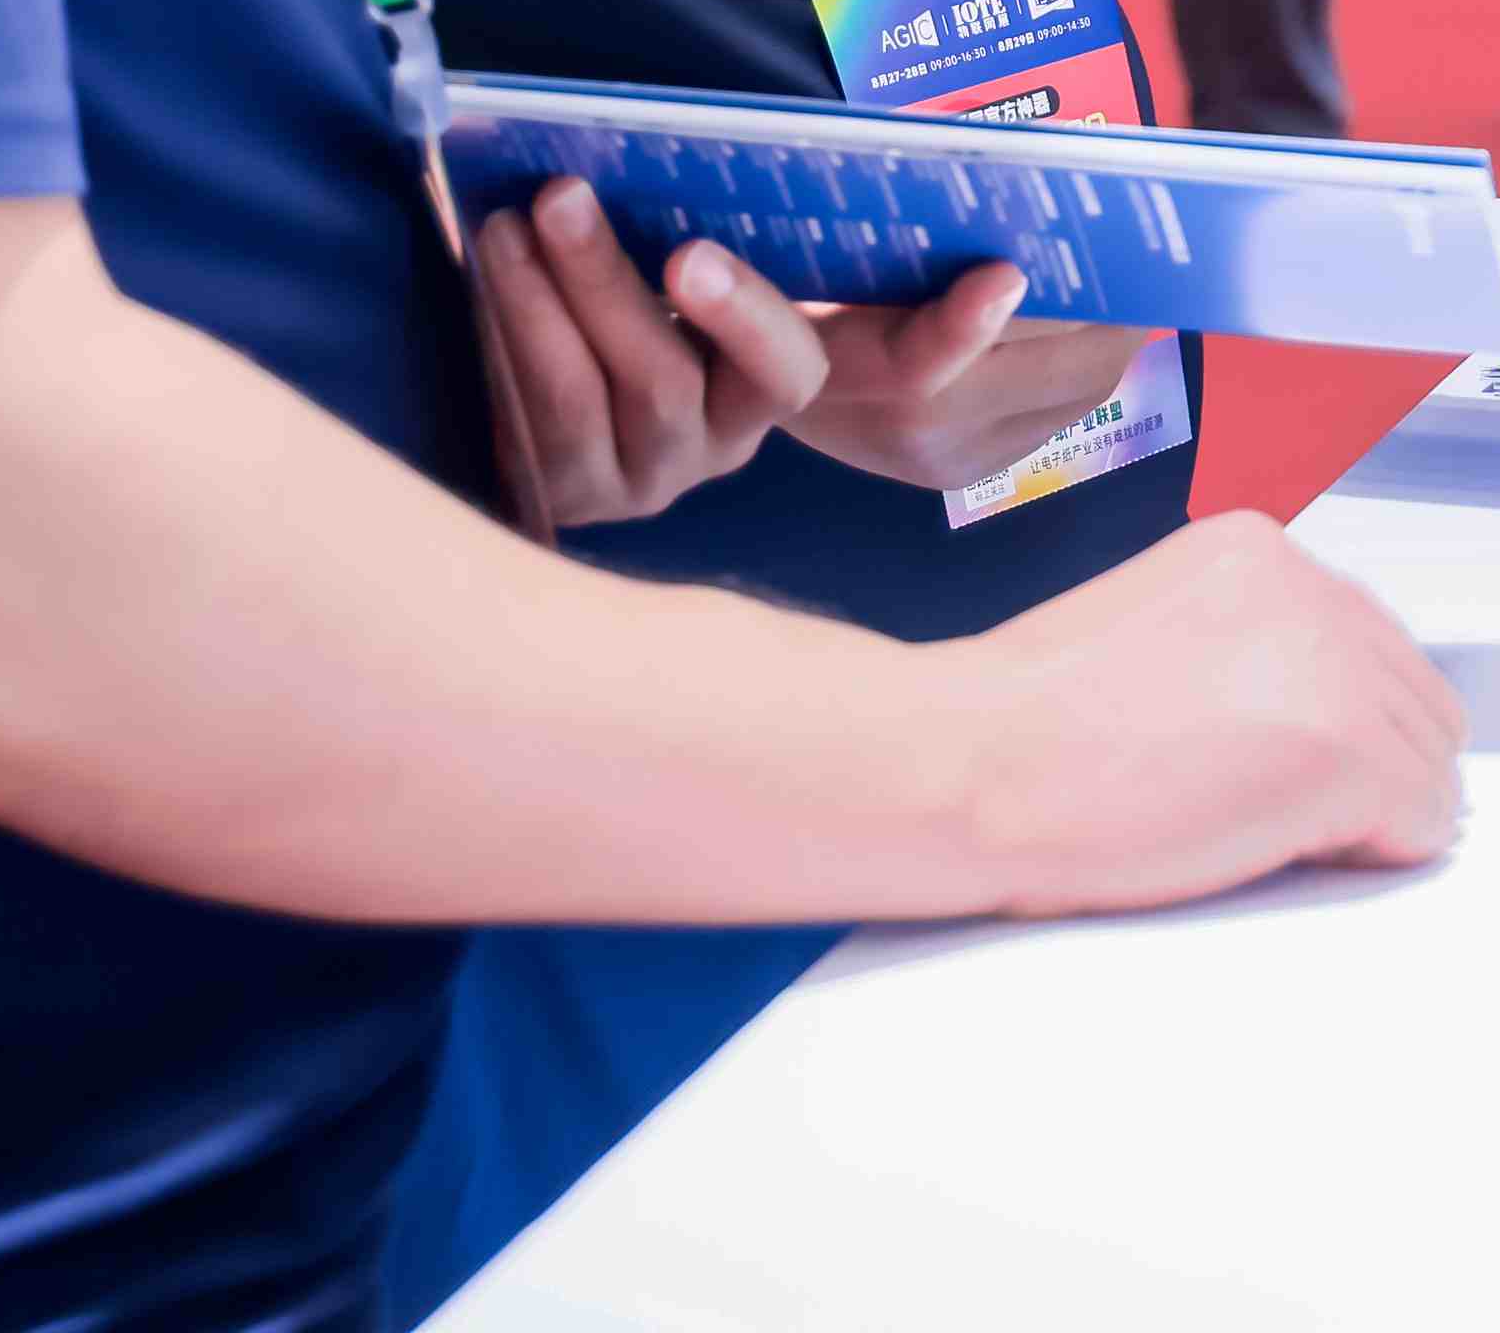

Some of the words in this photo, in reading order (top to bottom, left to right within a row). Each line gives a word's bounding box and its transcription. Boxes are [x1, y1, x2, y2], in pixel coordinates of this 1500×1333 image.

[880, 9, 941, 54] AGIC
[870, 62, 929, 90] 8月27-28日
[929, 45, 988, 72] 09:00-16:30
[997, 34, 1037, 54] 8月29日
